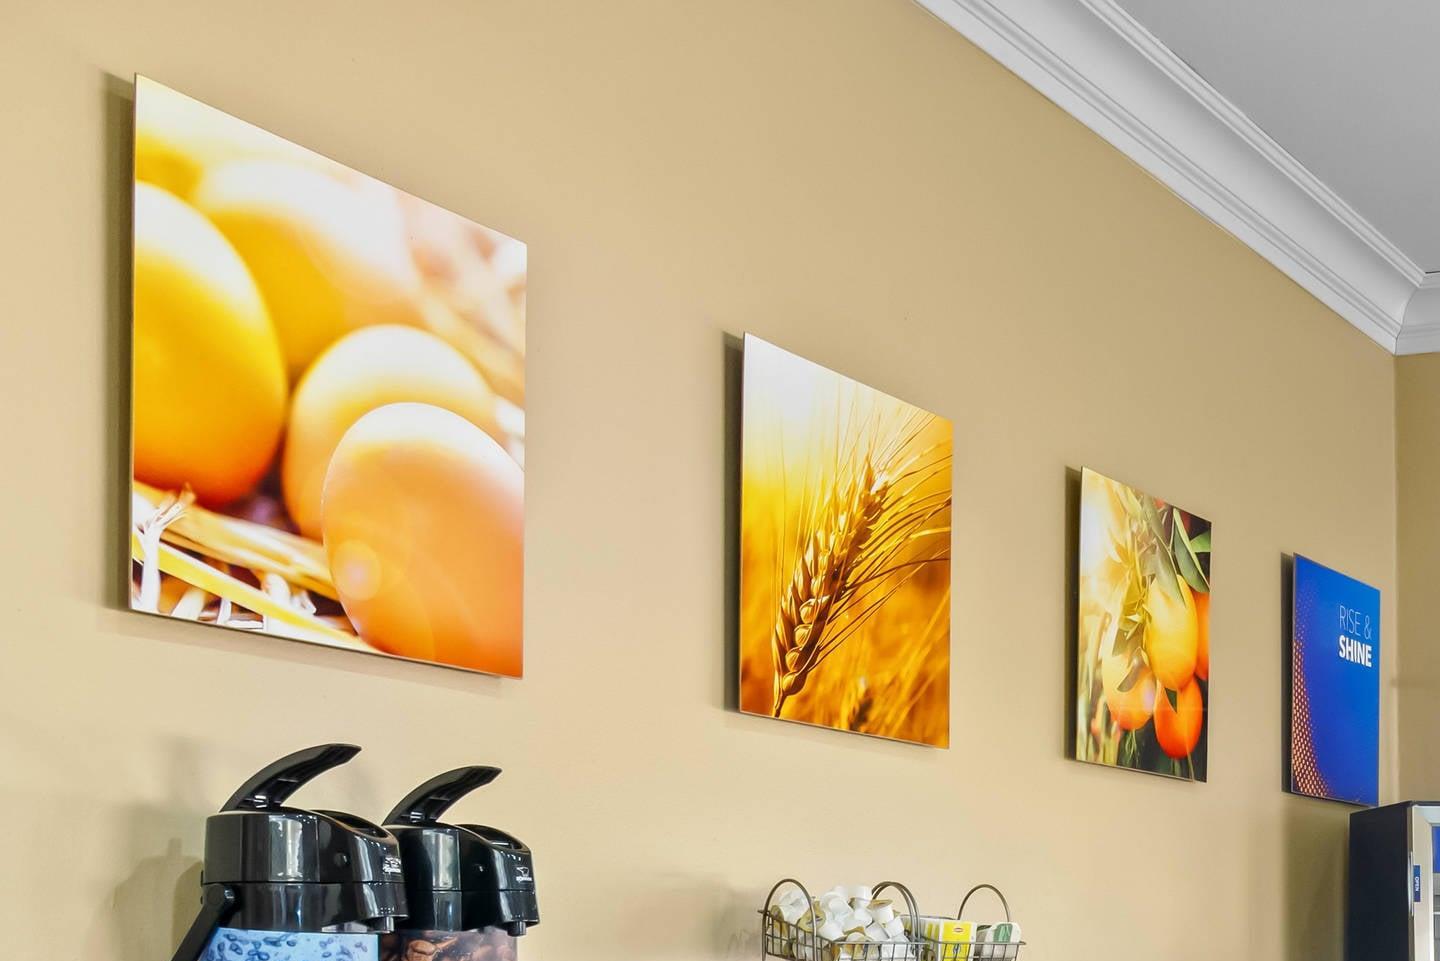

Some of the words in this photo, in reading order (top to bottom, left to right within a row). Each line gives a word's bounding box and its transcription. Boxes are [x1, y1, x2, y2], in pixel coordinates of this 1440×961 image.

[1339, 605, 1361, 637] RISE
[1363, 615, 1372, 640] &
[1338, 635, 1372, 667] SHINE
